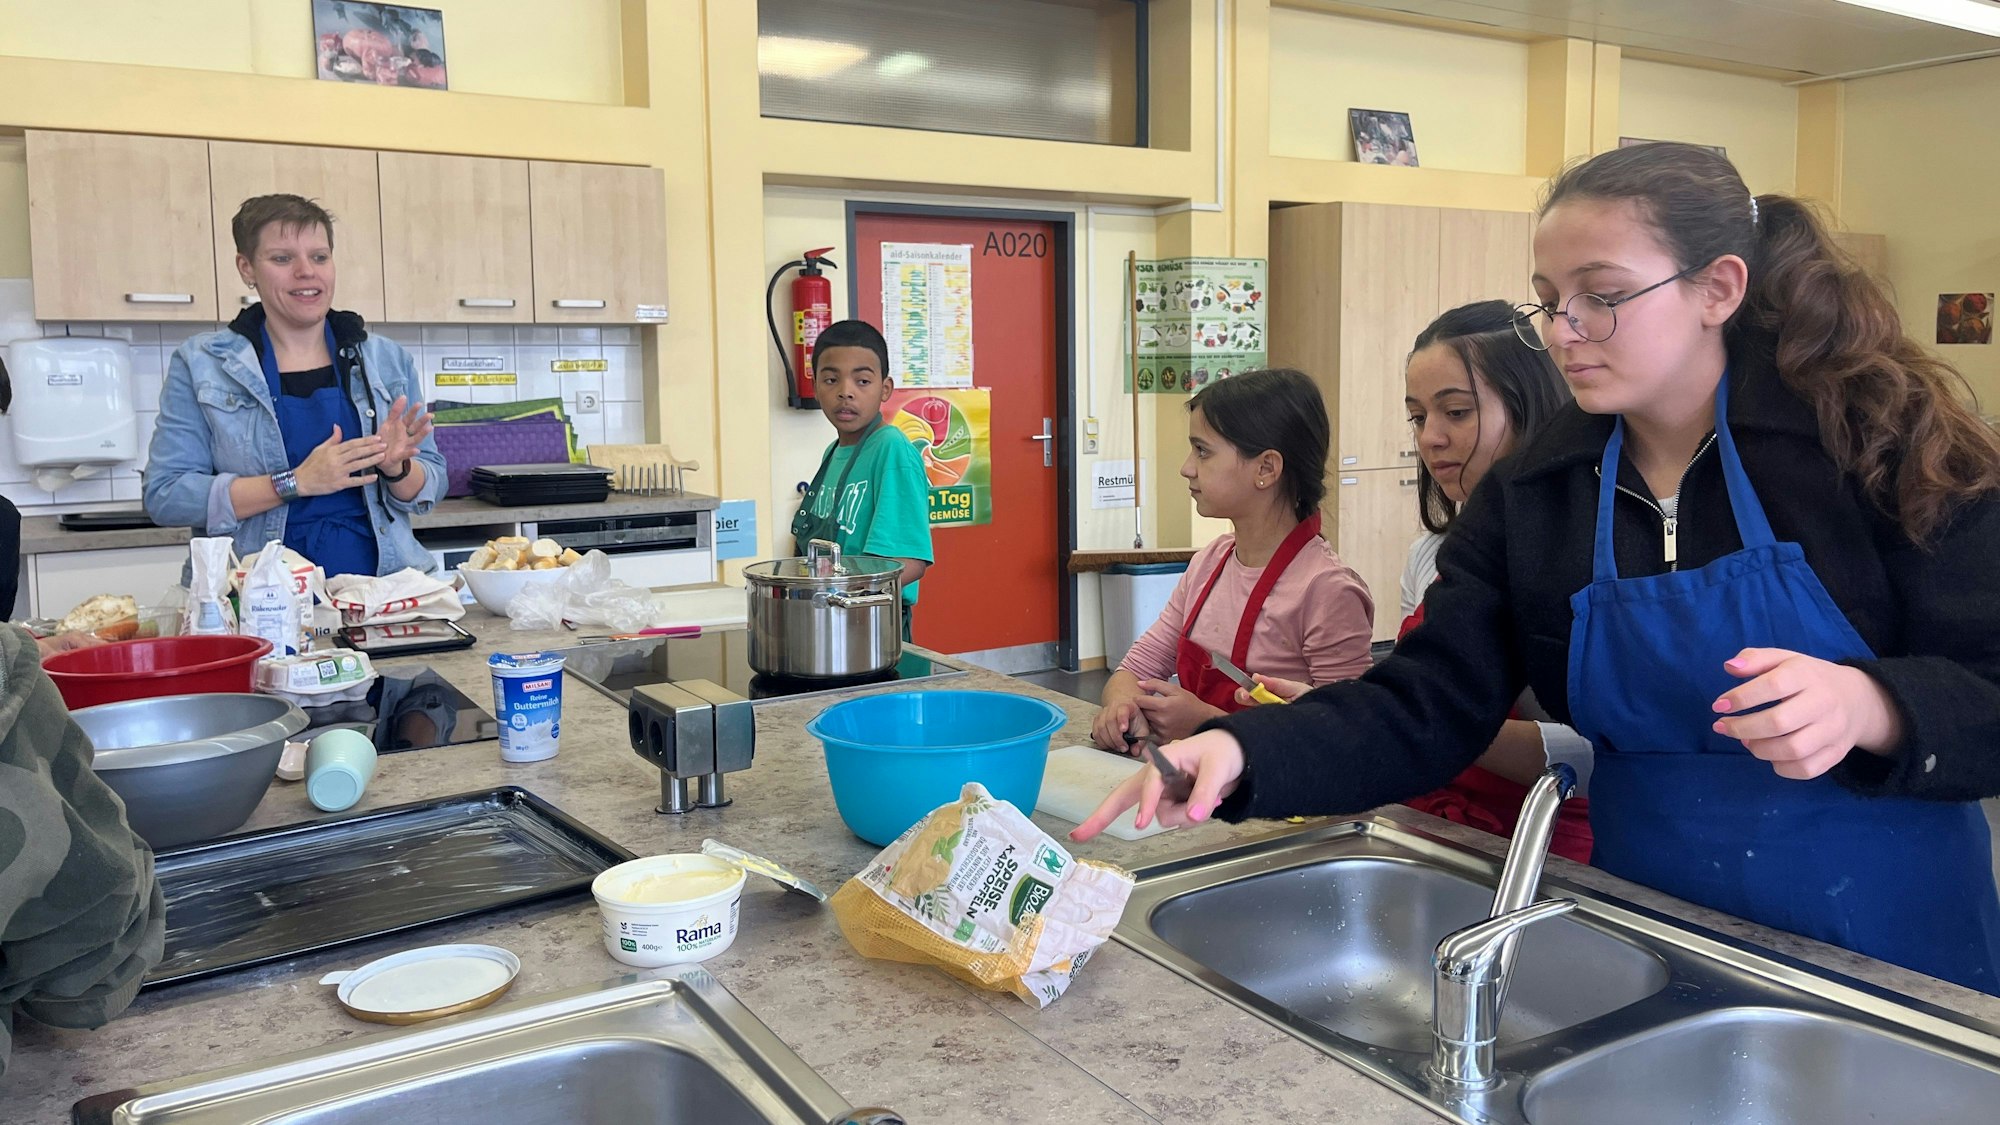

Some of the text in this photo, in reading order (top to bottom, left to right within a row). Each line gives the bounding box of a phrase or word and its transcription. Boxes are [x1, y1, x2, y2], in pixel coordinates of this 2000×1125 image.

[983, 231, 1047, 258] A020
[890, 251, 962, 261] aid-Saisonkalender
[1098, 474, 1135, 486] Restmü
[938, 490, 971, 509] Tag
[929, 508, 970, 520] GEMÜSE
[525, 681, 551, 690] MILSANI
[514, 697, 560, 710] Buttermilch
[966, 856, 992, 891] FESTKOCHEND
[966, 844, 1016, 919] KARTOFFELN
[984, 859, 1018, 913] SPEISE-
[676, 922, 721, 943] Rama
[677, 943, 698, 952] 100%
